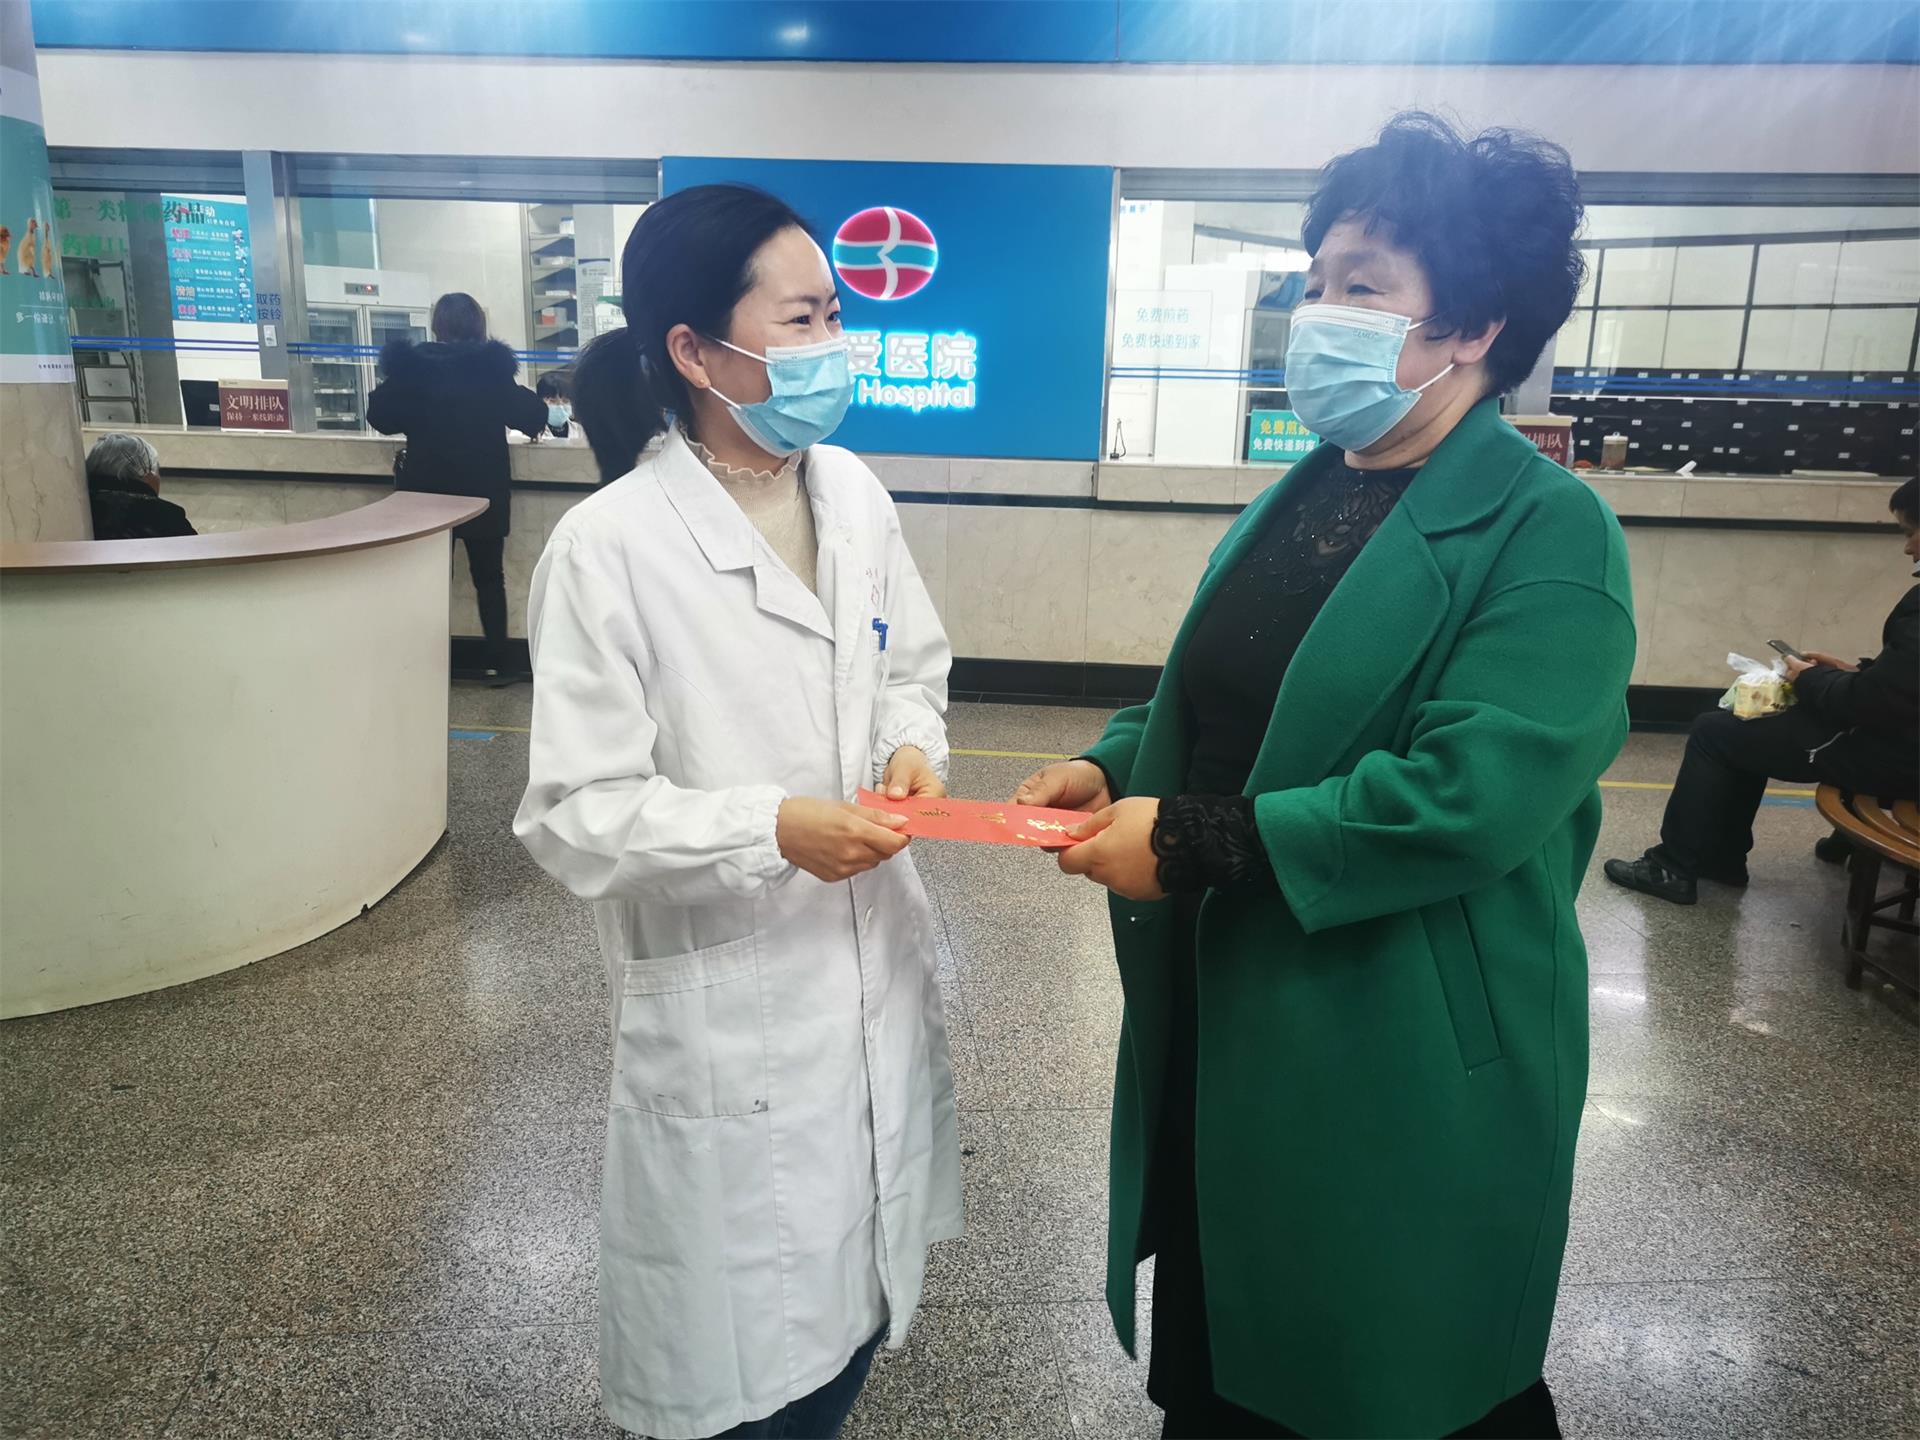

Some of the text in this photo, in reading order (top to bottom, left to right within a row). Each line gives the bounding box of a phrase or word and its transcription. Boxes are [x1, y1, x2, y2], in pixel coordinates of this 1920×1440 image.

[256, 293, 281, 306] 取药
[258, 307, 282, 320] 按铃
[858, 378, 976, 412] Hospital
[225, 394, 285, 411] 文明排队
[226, 411, 285, 423] 保持一米线距离
[1253, 437, 1317, 452] 免费快递到家
